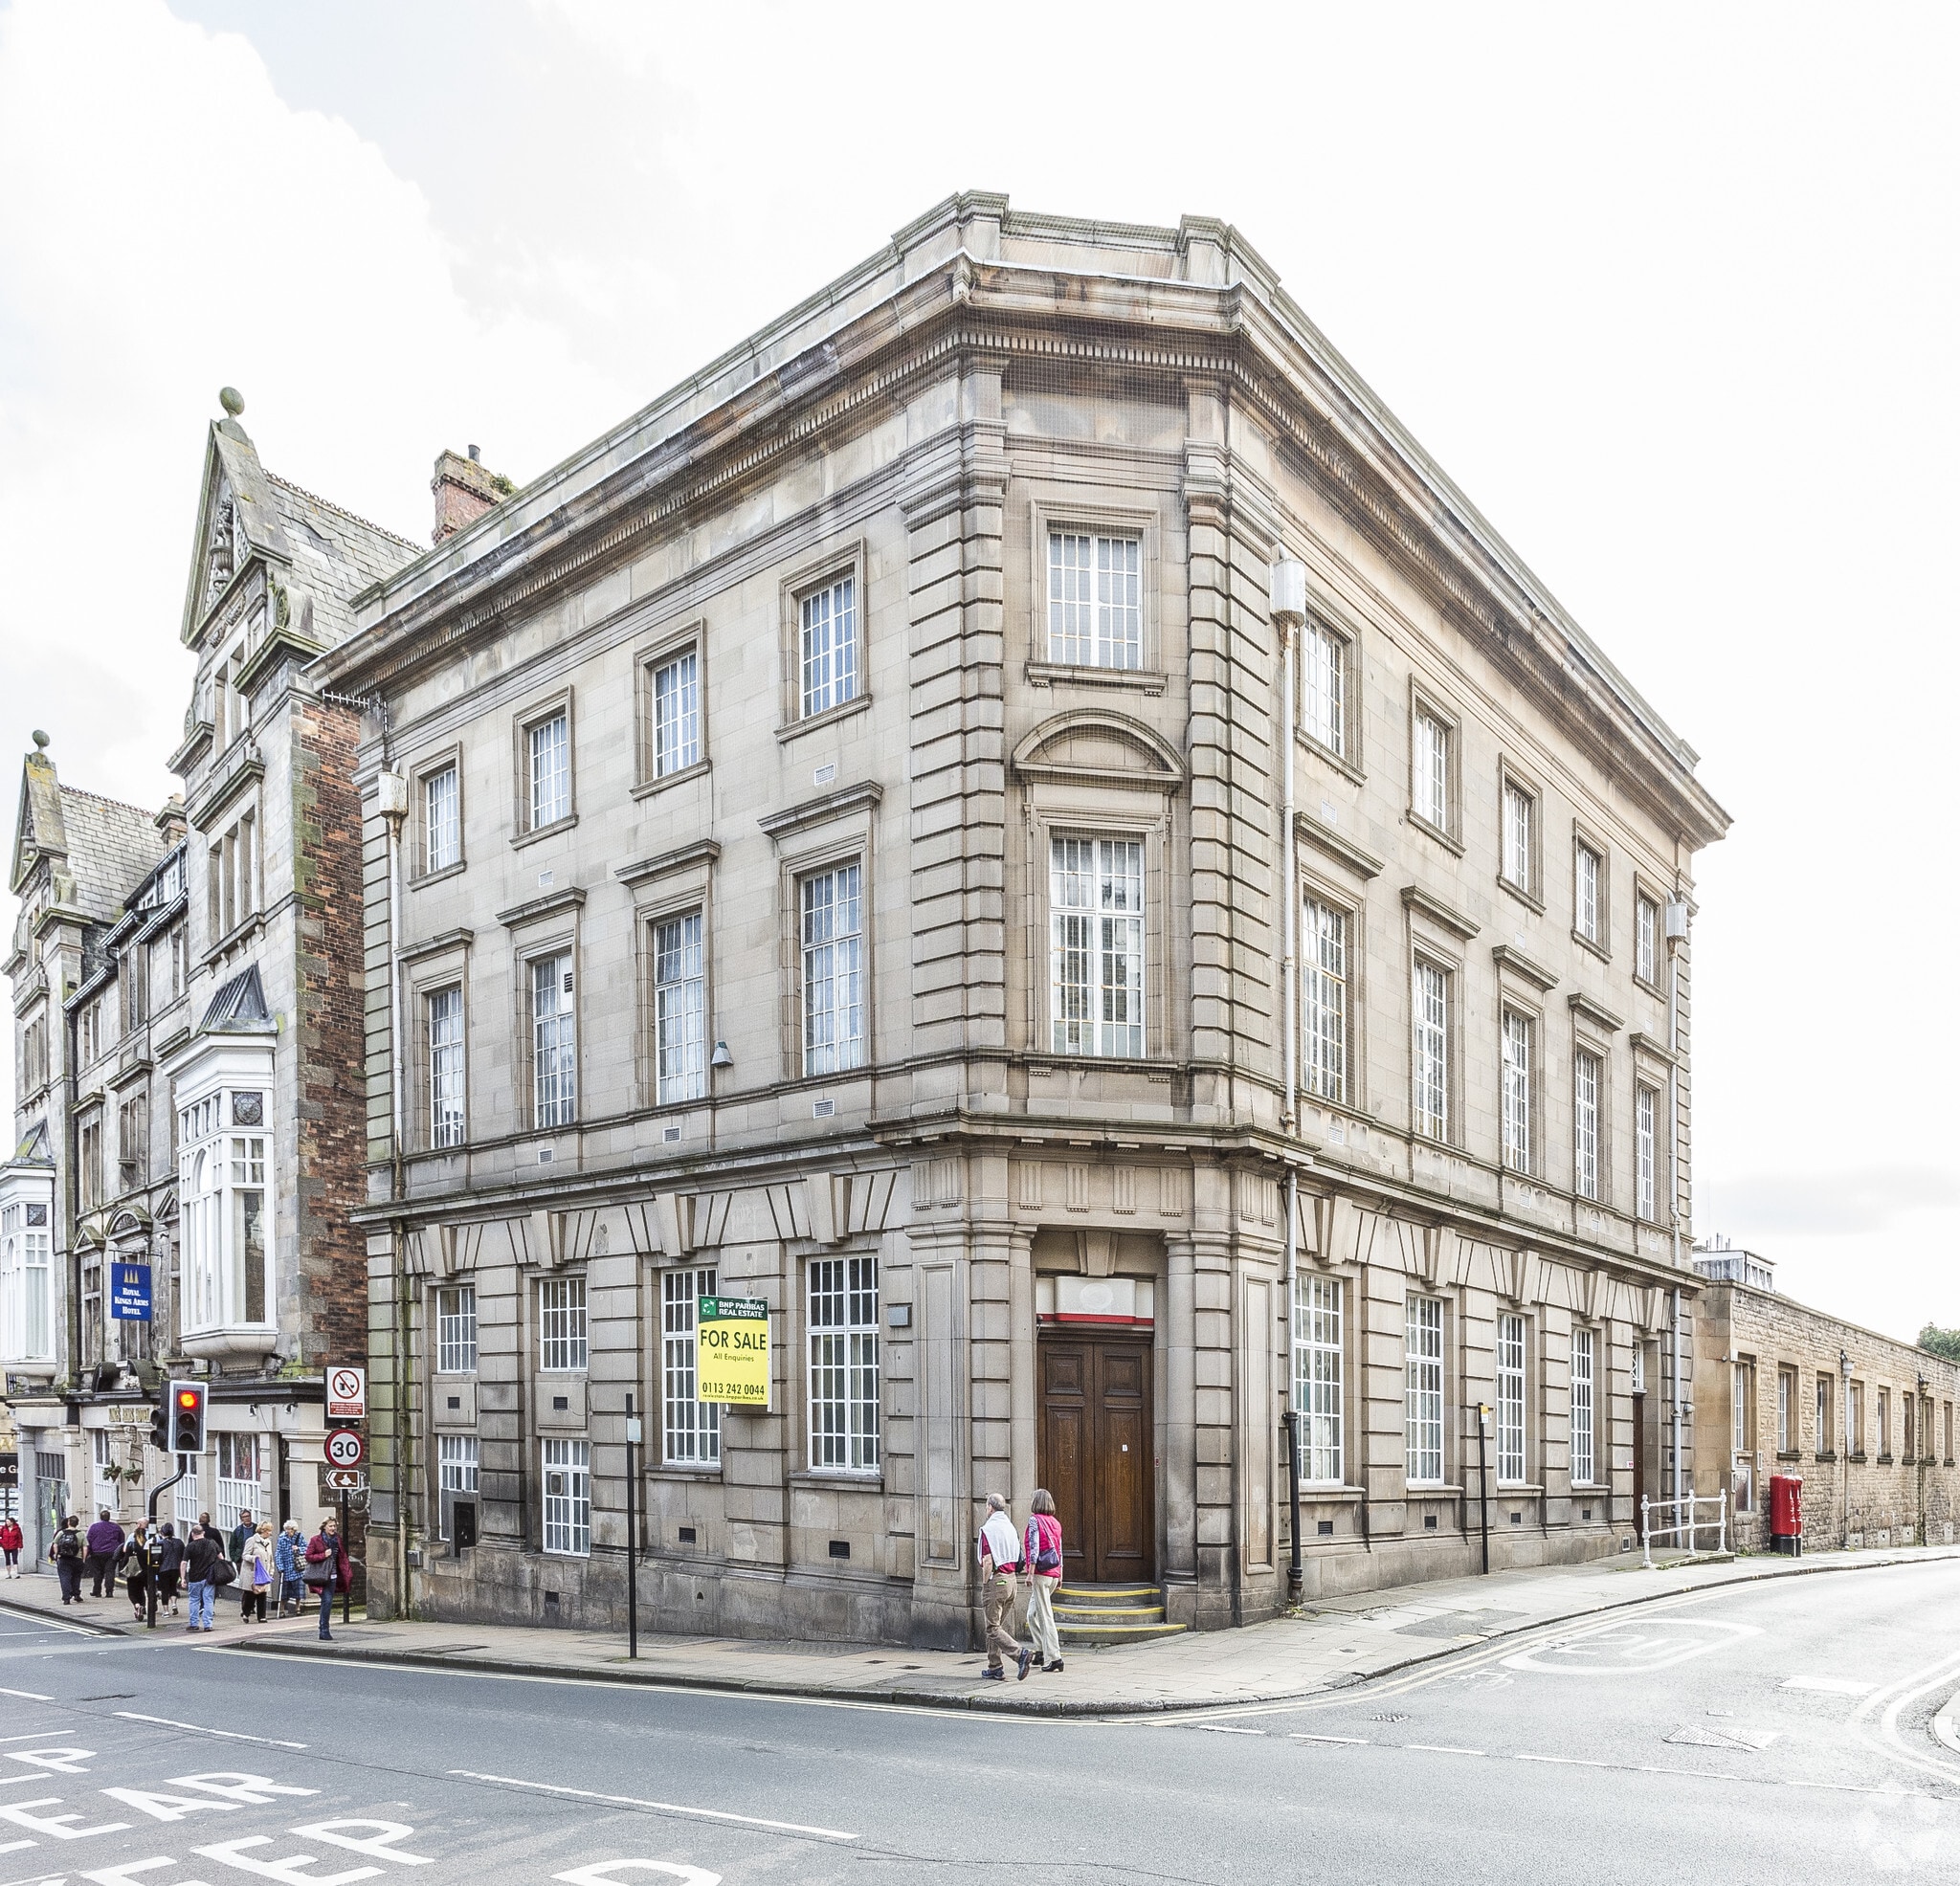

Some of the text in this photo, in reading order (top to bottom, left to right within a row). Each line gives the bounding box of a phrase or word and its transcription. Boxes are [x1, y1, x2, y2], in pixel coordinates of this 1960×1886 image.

[122, 1287, 142, 1297] ROYAL
[114, 1296, 149, 1307] KINGS ARMS
[735, 1302, 765, 1311] PARIBAS
[122, 1306, 142, 1316] HOTEL
[700, 1329, 767, 1350] FOR SALE
[724, 1354, 755, 1363] Enquiries
[702, 1382, 765, 1395] 0113 242 0044
[332, 1441, 359, 1458] 30
[0, 1772, 323, 1854] EAR
